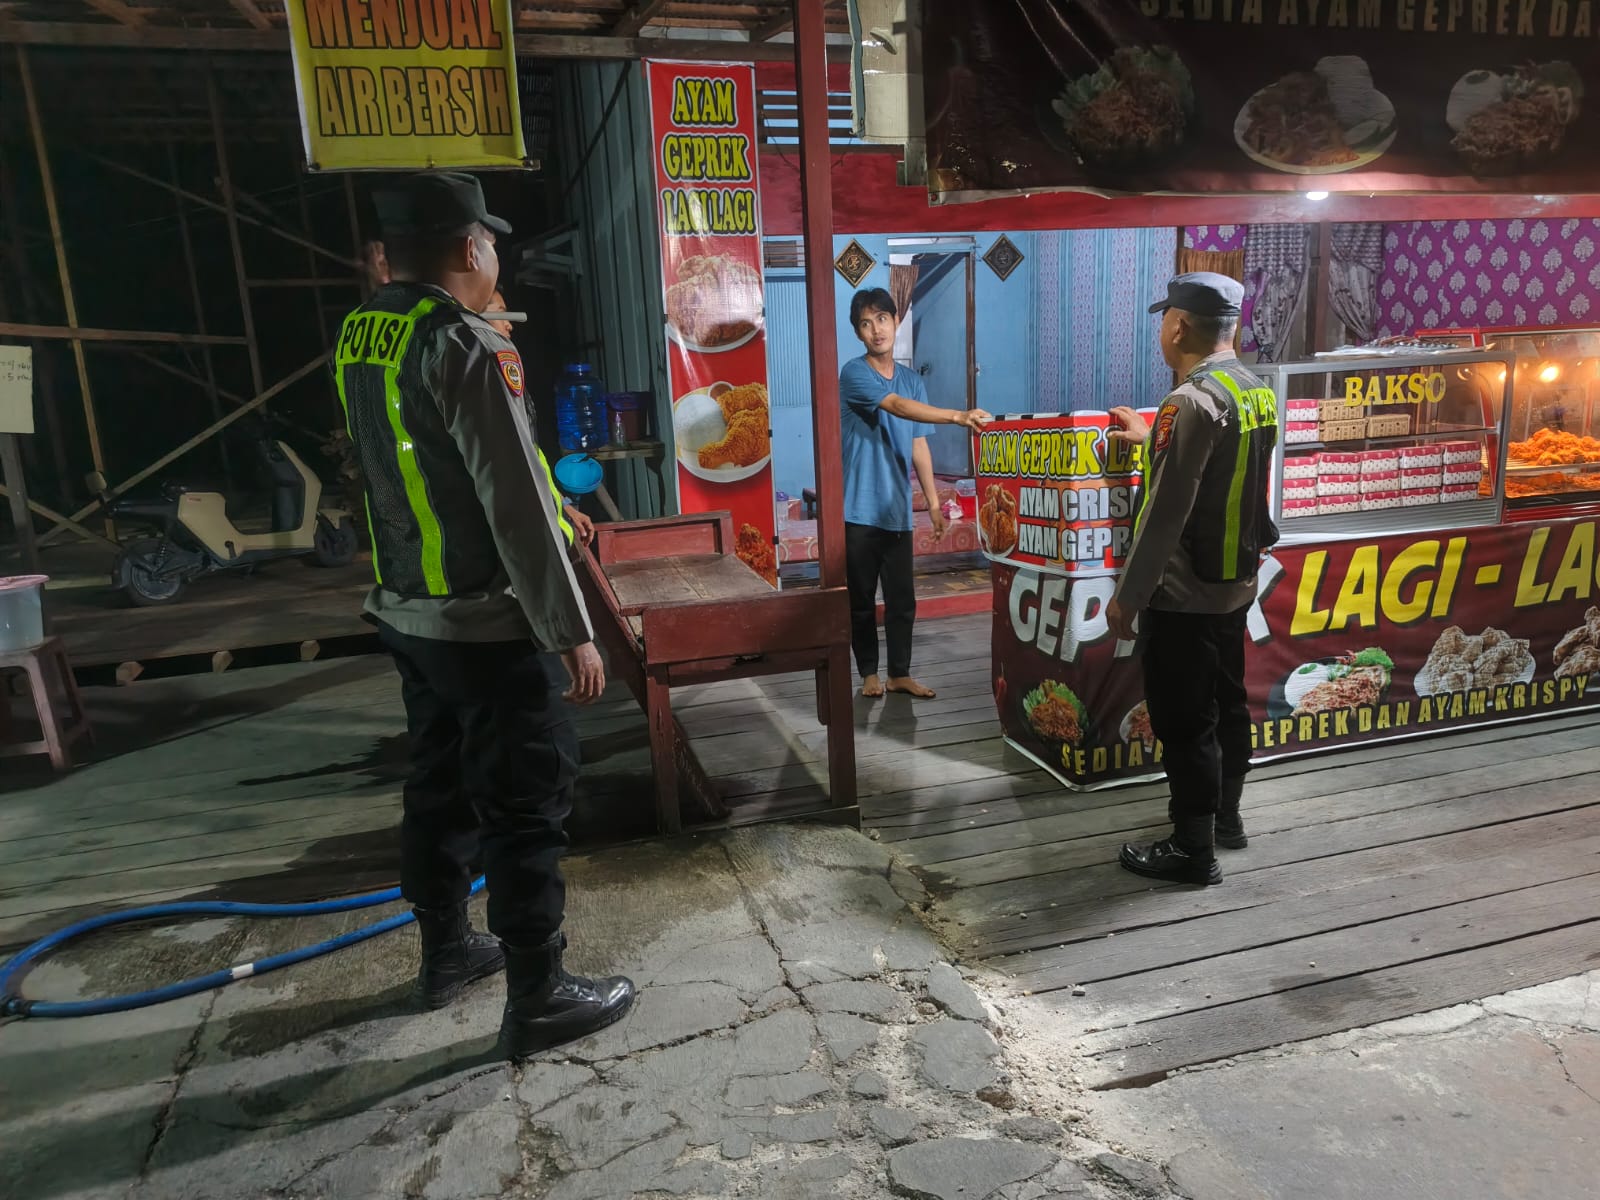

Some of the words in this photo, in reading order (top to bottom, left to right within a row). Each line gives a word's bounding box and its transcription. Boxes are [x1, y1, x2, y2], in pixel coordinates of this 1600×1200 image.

[304, 0, 503, 49] MENJUAL
[1397, 0, 1534, 36] GEPREK
[1548, 0, 1600, 37] DA
[673, 78, 737, 124] AYAM
[664, 135, 751, 180] GEPREK
[710, 190, 756, 233] LAGI
[340, 316, 408, 361] POLISI
[1344, 372, 1447, 407] BAKSO
[979, 434, 1018, 475] AYAM
[1019, 429, 1102, 477] GEPREK
[1018, 486, 1060, 520] AYAM
[1018, 522, 1059, 560] AYAM
[1290, 536, 1468, 636] LAGI
[1513, 521, 1600, 608] LA
[1061, 742, 1144, 776] SEDIA
[1358, 701, 1410, 733] DAN
[1417, 689, 1487, 724] AYAM
[1494, 674, 1589, 712] KRISPY
